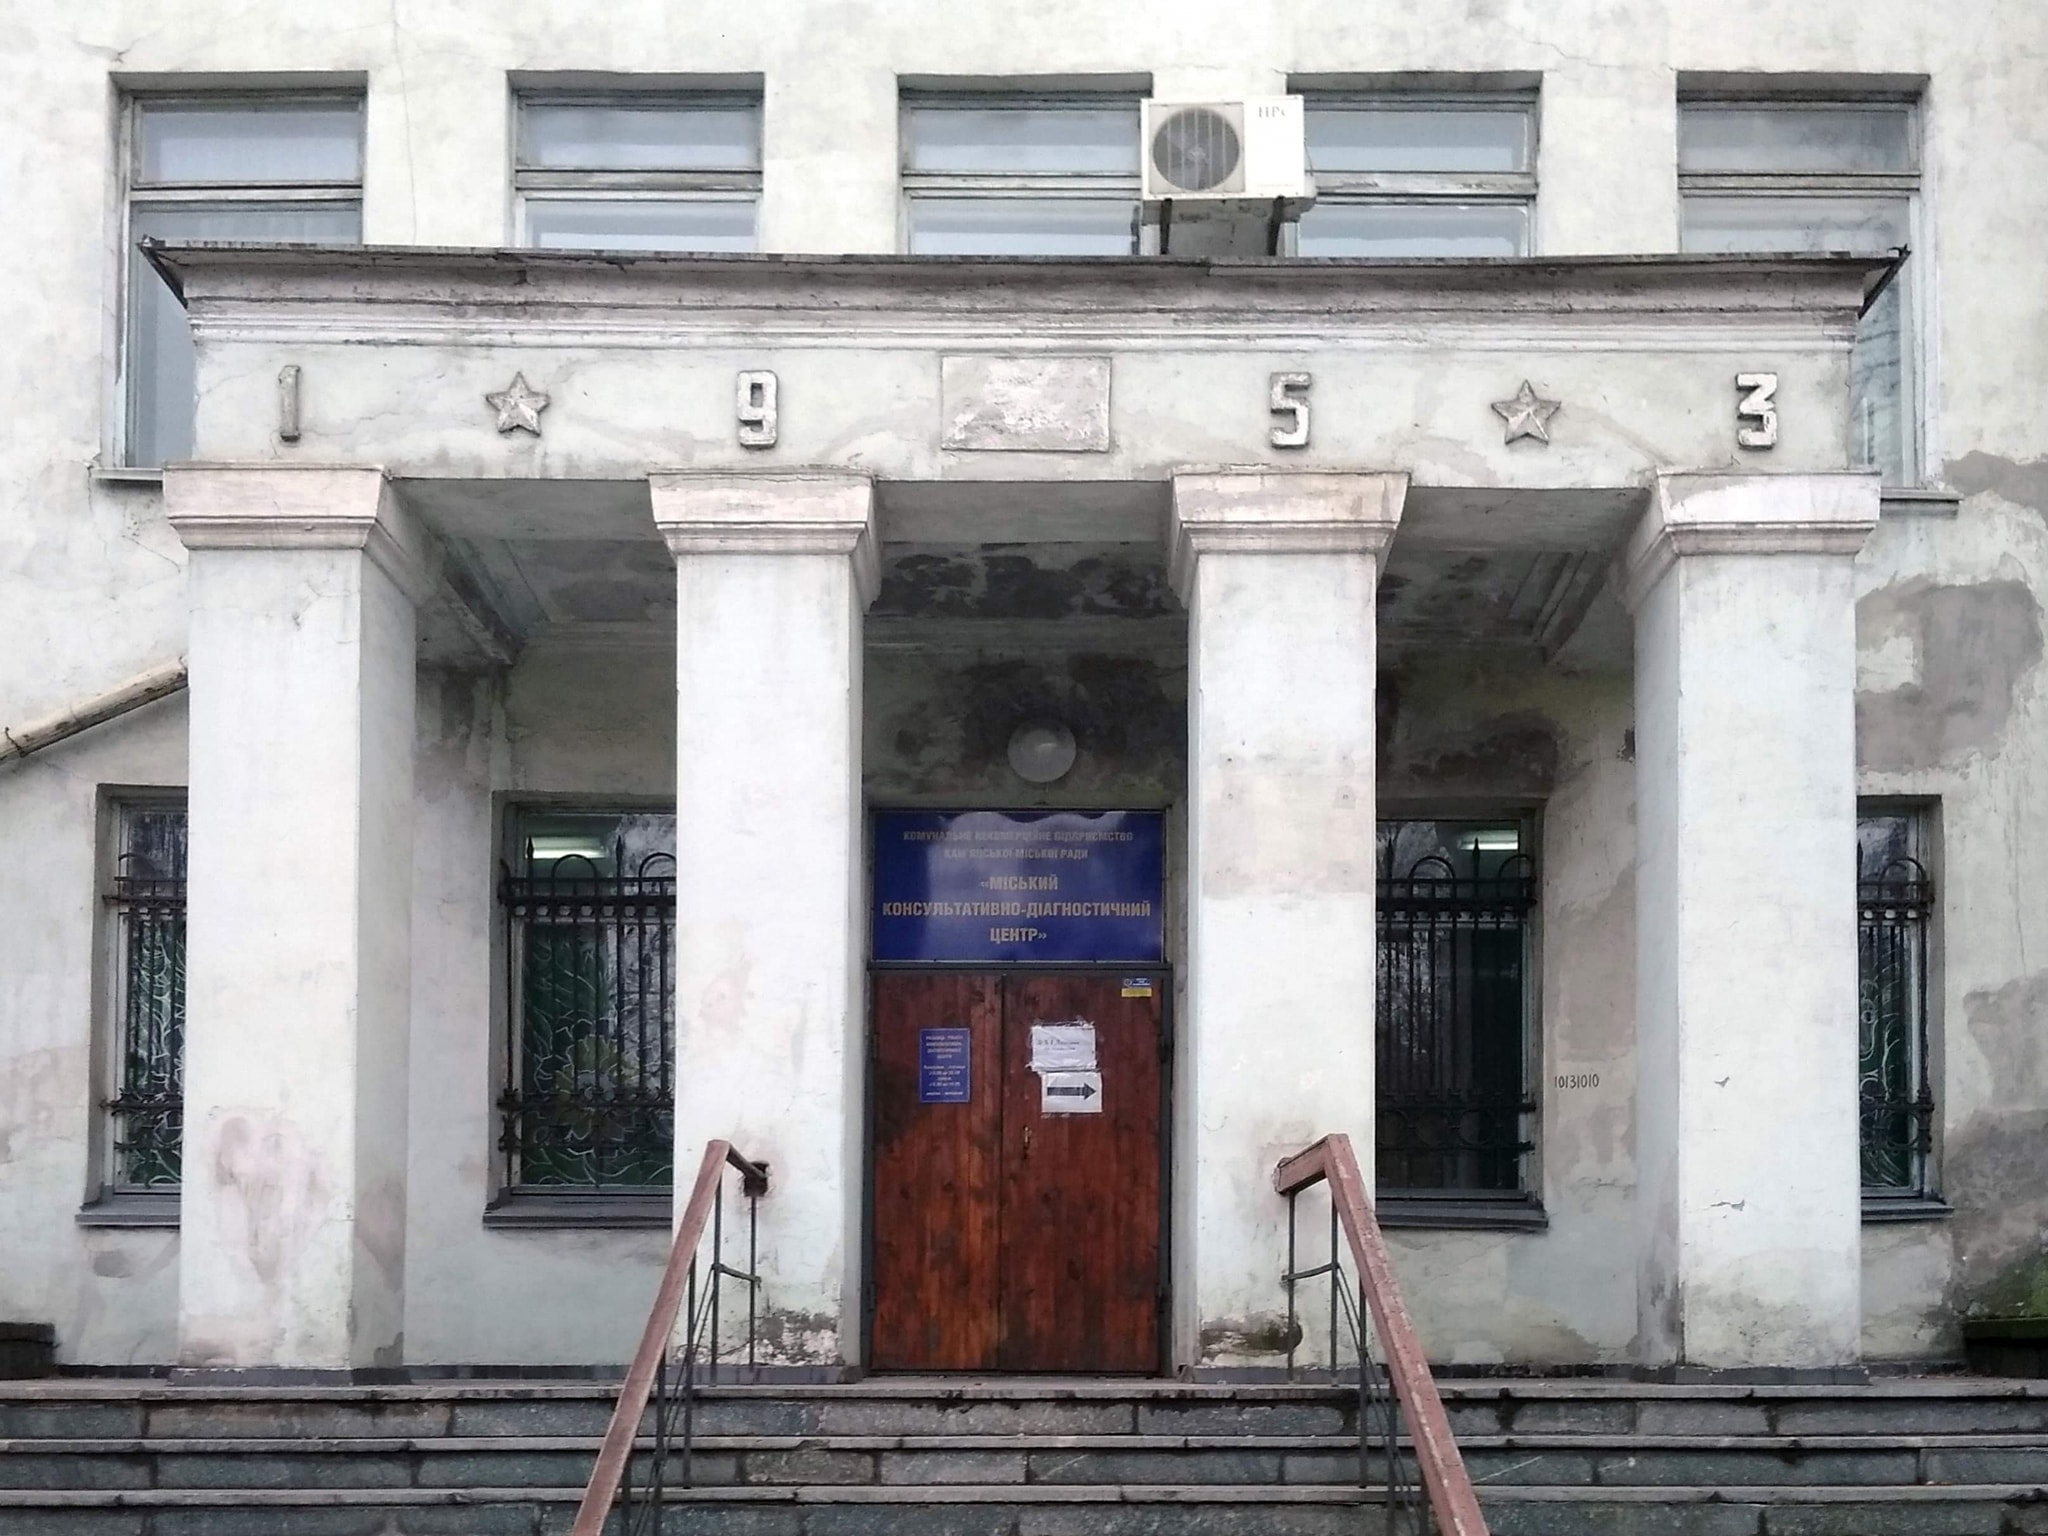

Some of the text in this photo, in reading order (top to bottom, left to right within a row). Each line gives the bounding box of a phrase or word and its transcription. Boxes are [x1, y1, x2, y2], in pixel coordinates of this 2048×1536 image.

[277, 364, 1778, 450] 1 9 5 3
[1061, 848, 1088, 860] РАДИ
[980, 874, 1058, 891] «МІСЬКИЙ
[882, 900, 1151, 918] КОНСУЛЬТАТИВНО-ДІАГНОСТИЧНИЙ
[990, 927, 1048, 944] ЦЕНТР»
[1554, 1073, 1600, 1089] 10131010
